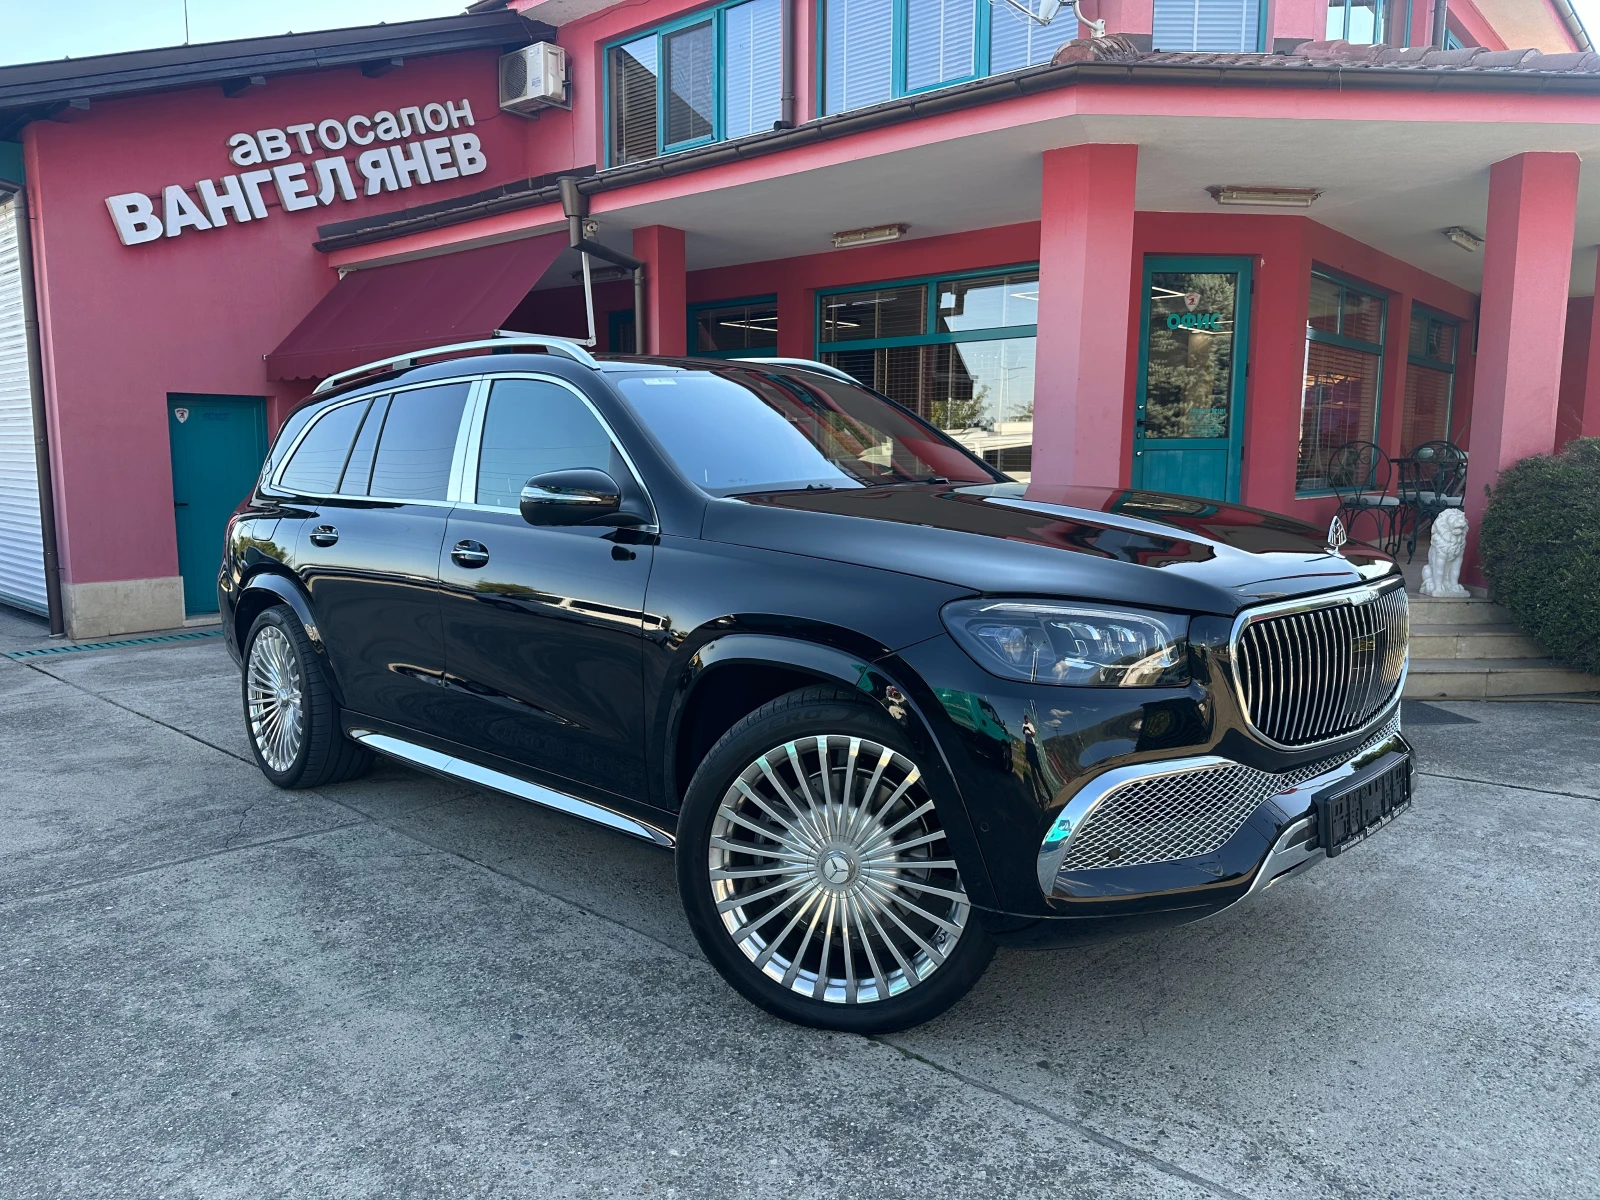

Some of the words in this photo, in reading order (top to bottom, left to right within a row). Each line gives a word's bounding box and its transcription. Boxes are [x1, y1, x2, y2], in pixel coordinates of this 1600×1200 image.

[227, 98, 475, 166] автосалон
[105, 156, 358, 246] ВАНГЕЛ
[355, 132, 487, 197] ЯНЕВ
[1167, 312, 1220, 329] ОФИС
